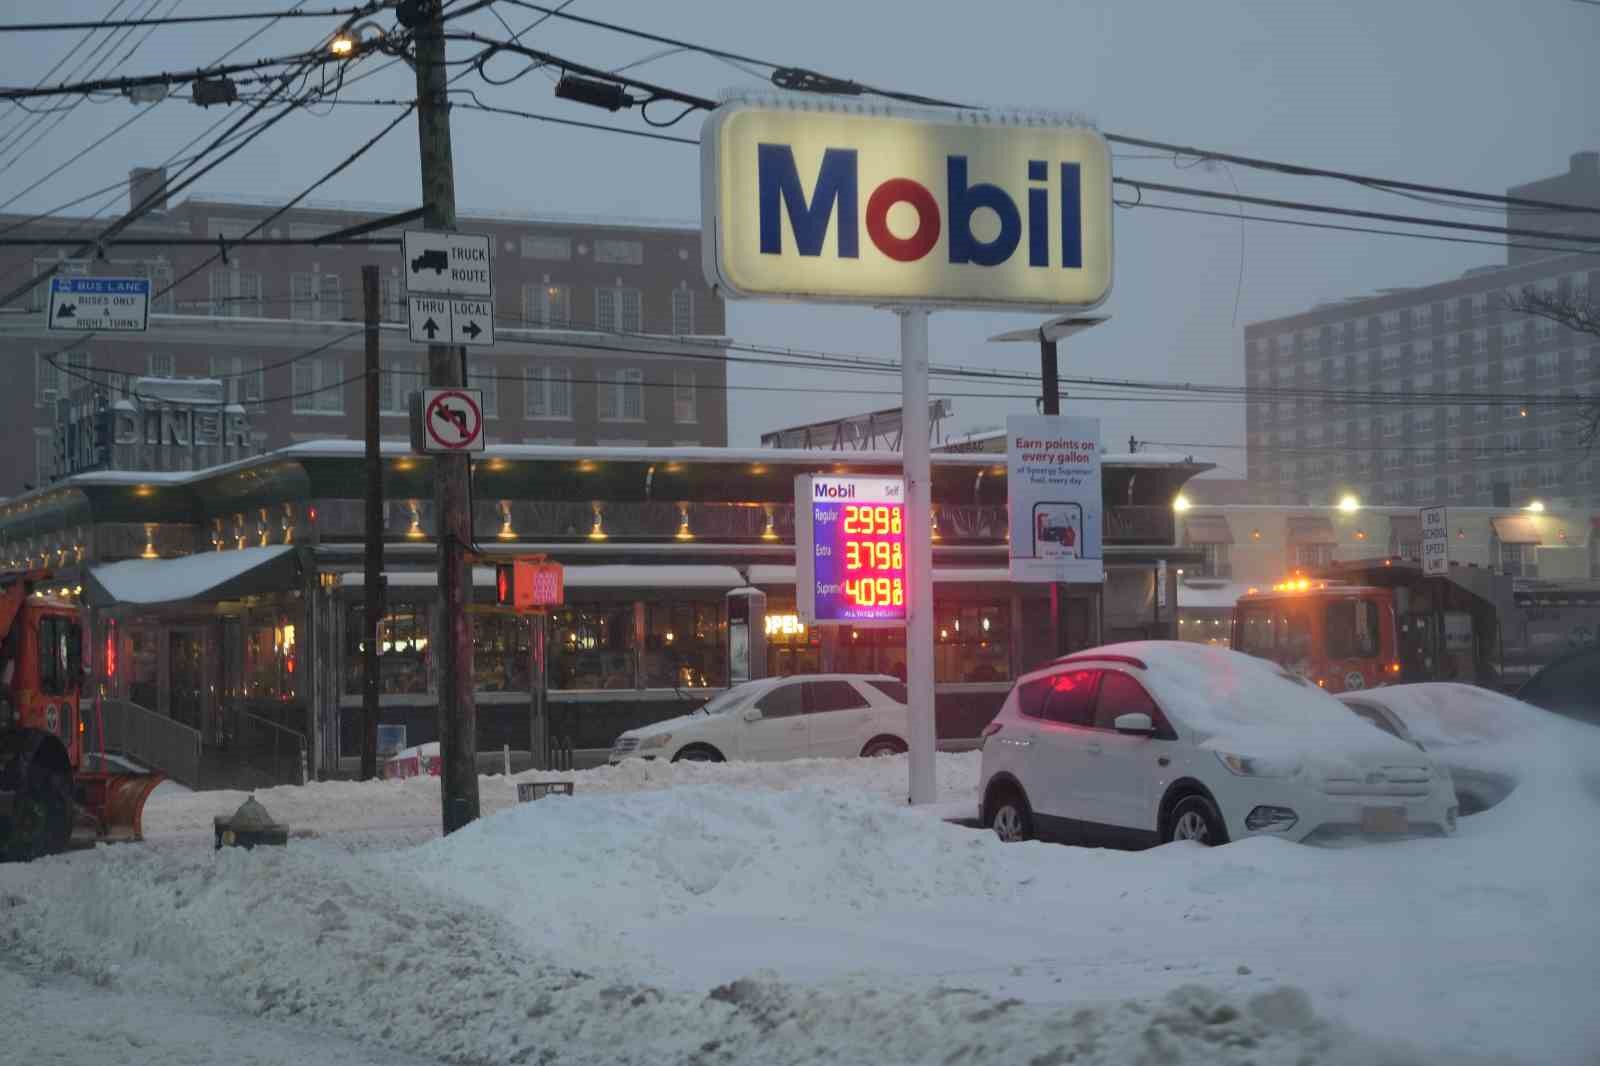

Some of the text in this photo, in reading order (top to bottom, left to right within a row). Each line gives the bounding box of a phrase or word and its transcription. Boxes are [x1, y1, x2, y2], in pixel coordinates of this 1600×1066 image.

[757, 143, 1083, 269] Mobil
[451, 247, 486, 261] TRUCK
[451, 269, 486, 282] ROUTE
[78, 280, 141, 291] BUS LANE
[113, 296, 136, 304] ONLY
[416, 300, 444, 312] THRU
[454, 303, 488, 316] LOCAL
[110, 320, 138, 329] TURNS
[113, 408, 251, 446] DINER
[1016, 437, 1095, 451] Earn points on
[1022, 451, 1089, 464] every gallon
[815, 484, 899, 498] Mobil Self
[815, 508, 839, 524] Regular
[844, 506, 889, 534] 2.99
[1427, 511, 1440, 525] END
[815, 544, 832, 556] Extra
